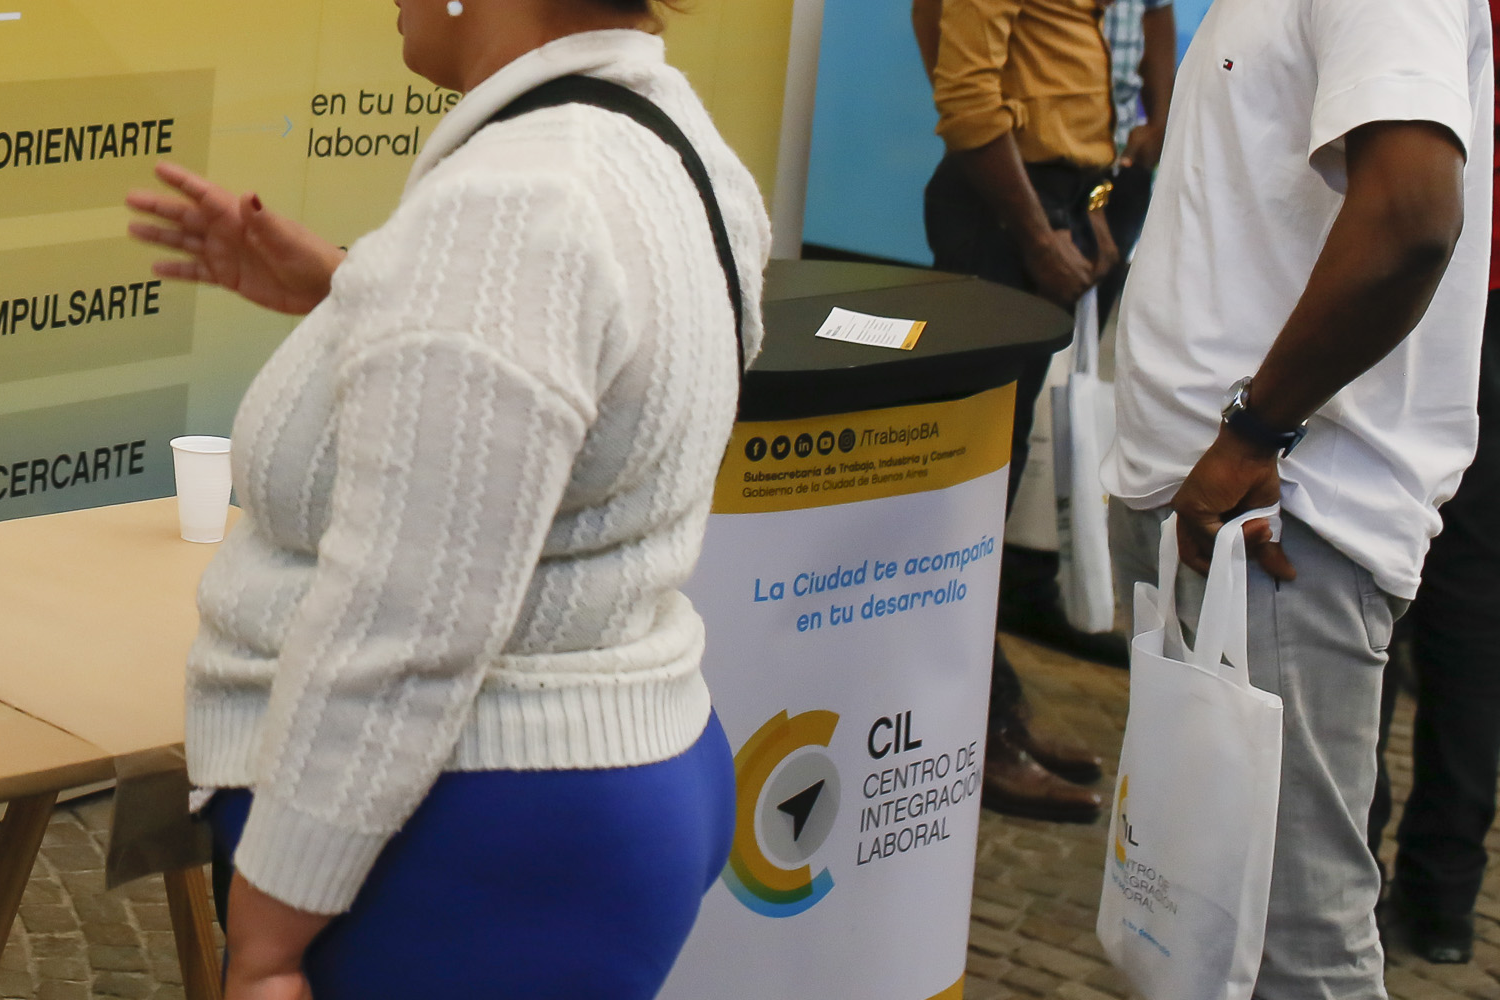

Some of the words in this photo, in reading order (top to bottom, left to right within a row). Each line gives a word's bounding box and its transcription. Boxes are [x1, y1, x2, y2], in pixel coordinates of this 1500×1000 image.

[311, 93, 346, 116] en
[358, 89, 394, 115] tu
[860, 422, 940, 448] /TrabajoBA
[742, 484, 794, 499] Gobierno
[795, 482, 808, 496] de
[810, 480, 820, 493] la
[822, 476, 856, 491] Ciudad
[857, 474, 870, 487] de
[871, 471, 904, 485] Buenos
[905, 467, 928, 481] Aires
[743, 464, 822, 483] Subsecretaría
[824, 463, 837, 477] de
[879, 455, 920, 469] Industria
[753, 578, 785, 602] La
[793, 560, 868, 598] Ciudad
[873, 560, 898, 581] te
[903, 534, 995, 575] acompaña
[796, 611, 822, 632] en
[829, 604, 854, 626] tu
[861, 578, 968, 620] desarrollo
[867, 710, 923, 760] CIL
[862, 753, 950, 799] CENTRO
[956, 741, 977, 773] DE
[856, 816, 951, 866] LABORAL
